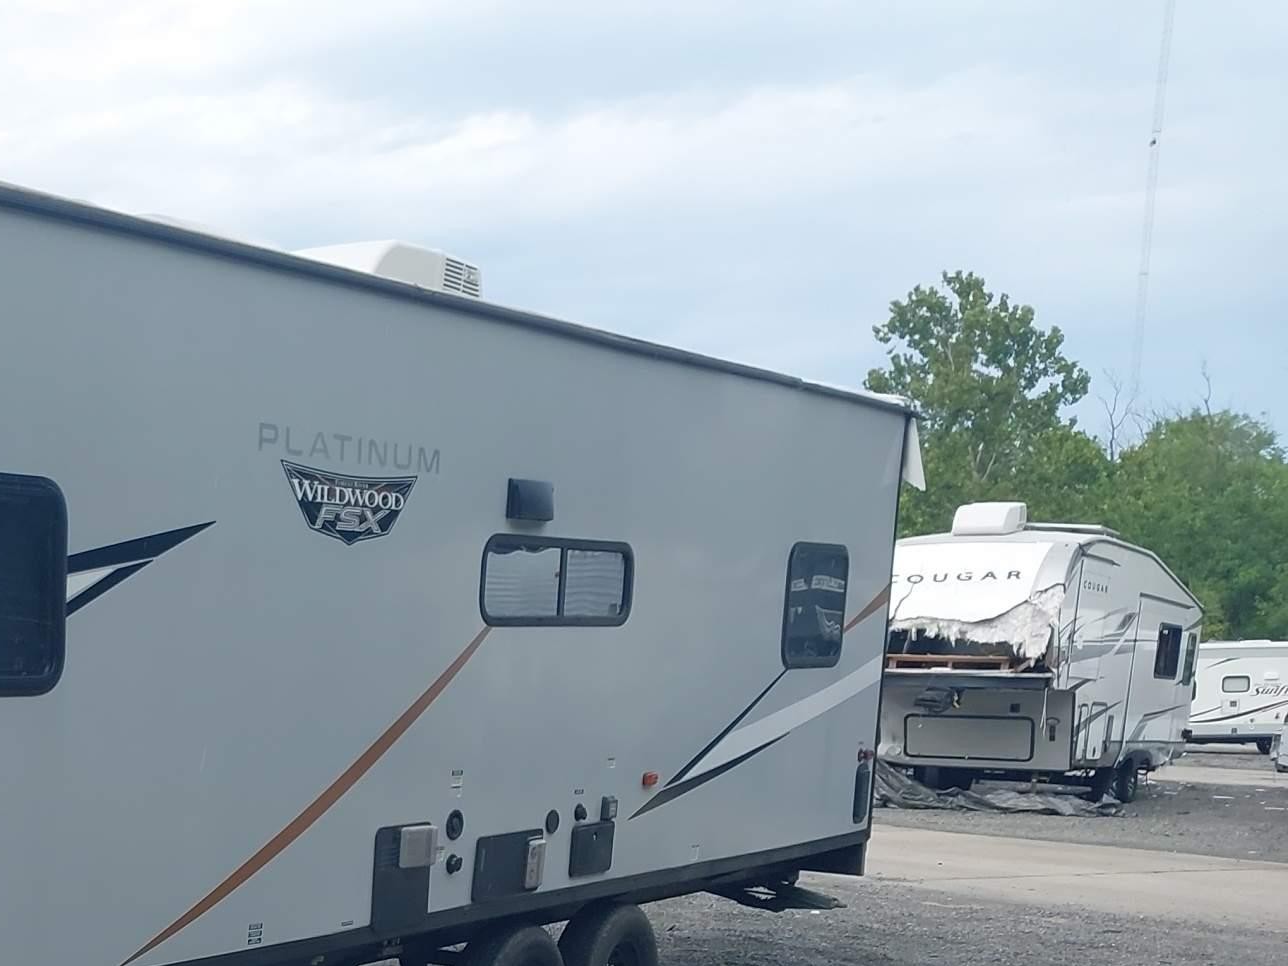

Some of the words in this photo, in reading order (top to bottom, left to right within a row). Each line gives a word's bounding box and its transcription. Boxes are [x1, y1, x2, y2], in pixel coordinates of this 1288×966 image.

[257, 422, 441, 474] PLATINUM
[292, 478, 404, 511] WILDWOOD
[314, 503, 391, 534] FSX
